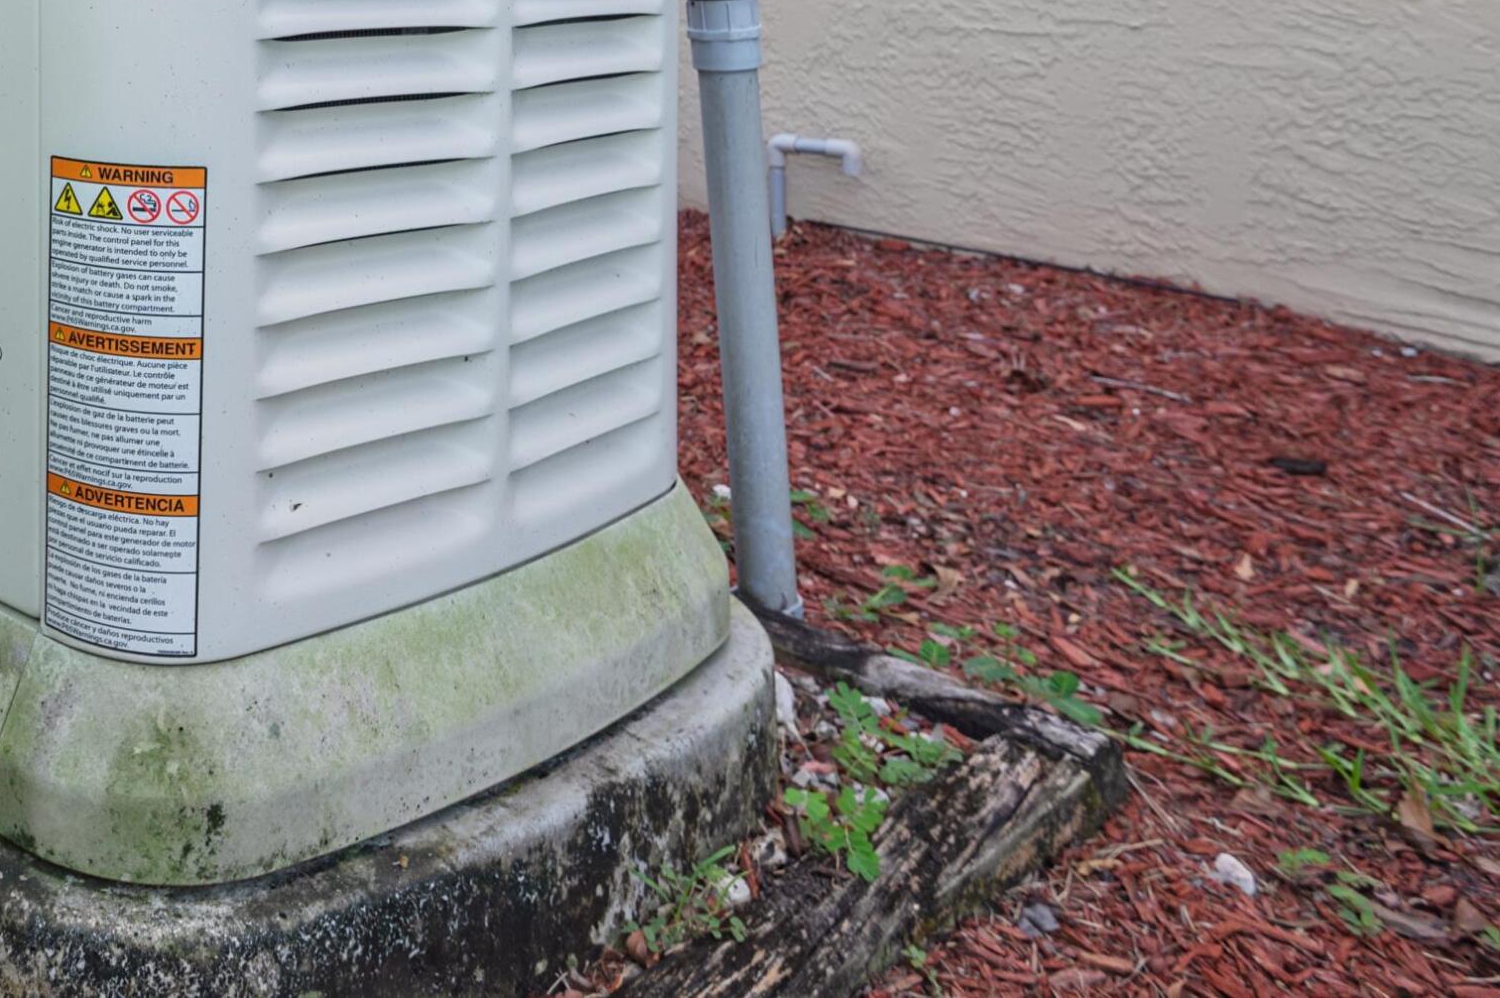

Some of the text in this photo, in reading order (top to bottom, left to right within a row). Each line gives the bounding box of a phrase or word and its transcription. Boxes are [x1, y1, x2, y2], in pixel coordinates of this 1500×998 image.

[98, 166, 174, 184] WARNING
[72, 220, 95, 230] electric
[121, 227, 131, 235] No
[152, 229, 193, 237] serviceable
[89, 233, 180, 247] The control panel for this
[89, 254, 120, 265] qualified
[115, 248, 148, 256] intended
[160, 250, 175, 259] only
[89, 267, 114, 279] battery
[116, 273, 136, 281] gases
[103, 292, 123, 300] cause
[132, 293, 152, 302] spark
[81, 297, 92, 305] this
[94, 299, 119, 310] battery
[121, 303, 175, 313] compartment.
[85, 312, 130, 324] reproductive
[69, 332, 196, 355] AVERTISSEMENT
[137, 361, 166, 369] Aucune
[167, 362, 188, 370] pièce
[134, 370, 142, 378] Le
[144, 370, 175, 380] contrôle
[137, 380, 147, 388] de
[149, 381, 176, 390] moteur
[114, 390, 159, 400] uniquement
[161, 394, 174, 402] par
[93, 411, 104, 419] gaz
[106, 411, 115, 420] de
[117, 413, 124, 421] la
[126, 414, 155, 424] batterie
[115, 424, 138, 434] graves
[152, 427, 158, 435] la
[102, 434, 114, 442] pas
[116, 435, 143, 445] allumer
[137, 447, 168, 458] étincelle
[95, 454, 146, 468] compartiment
[93, 467, 110, 477] nocif
[125, 472, 131, 480] la
[133, 473, 182, 484] reproduction
[75, 486, 185, 512] ADVERTENCIA
[87, 519, 112, 531] usuario
[114, 525, 137, 535] pueda
[143, 517, 154, 525] No
[156, 518, 170, 528] hay
[88, 530, 102, 540] para
[104, 534, 119, 542] este
[121, 536, 160, 547] generador
[110, 544, 140, 556] operado
[96, 551, 122, 563] servicio
[92, 565, 101, 575] los
[103, 569, 121, 579] gases
[123, 572, 132, 581] de
[134, 573, 140, 581] la
[142, 574, 167, 584] batería
[106, 581, 132, 592] severos
[140, 585, 146, 593] la
[107, 590, 138, 604] encienda
[140, 596, 166, 606] cerillos
[100, 600, 105, 608] la
[109, 602, 141, 615] vecindad
[143, 607, 152, 615] de
[98, 626, 119, 638] daños
[121, 633, 173, 645] reproductivos
